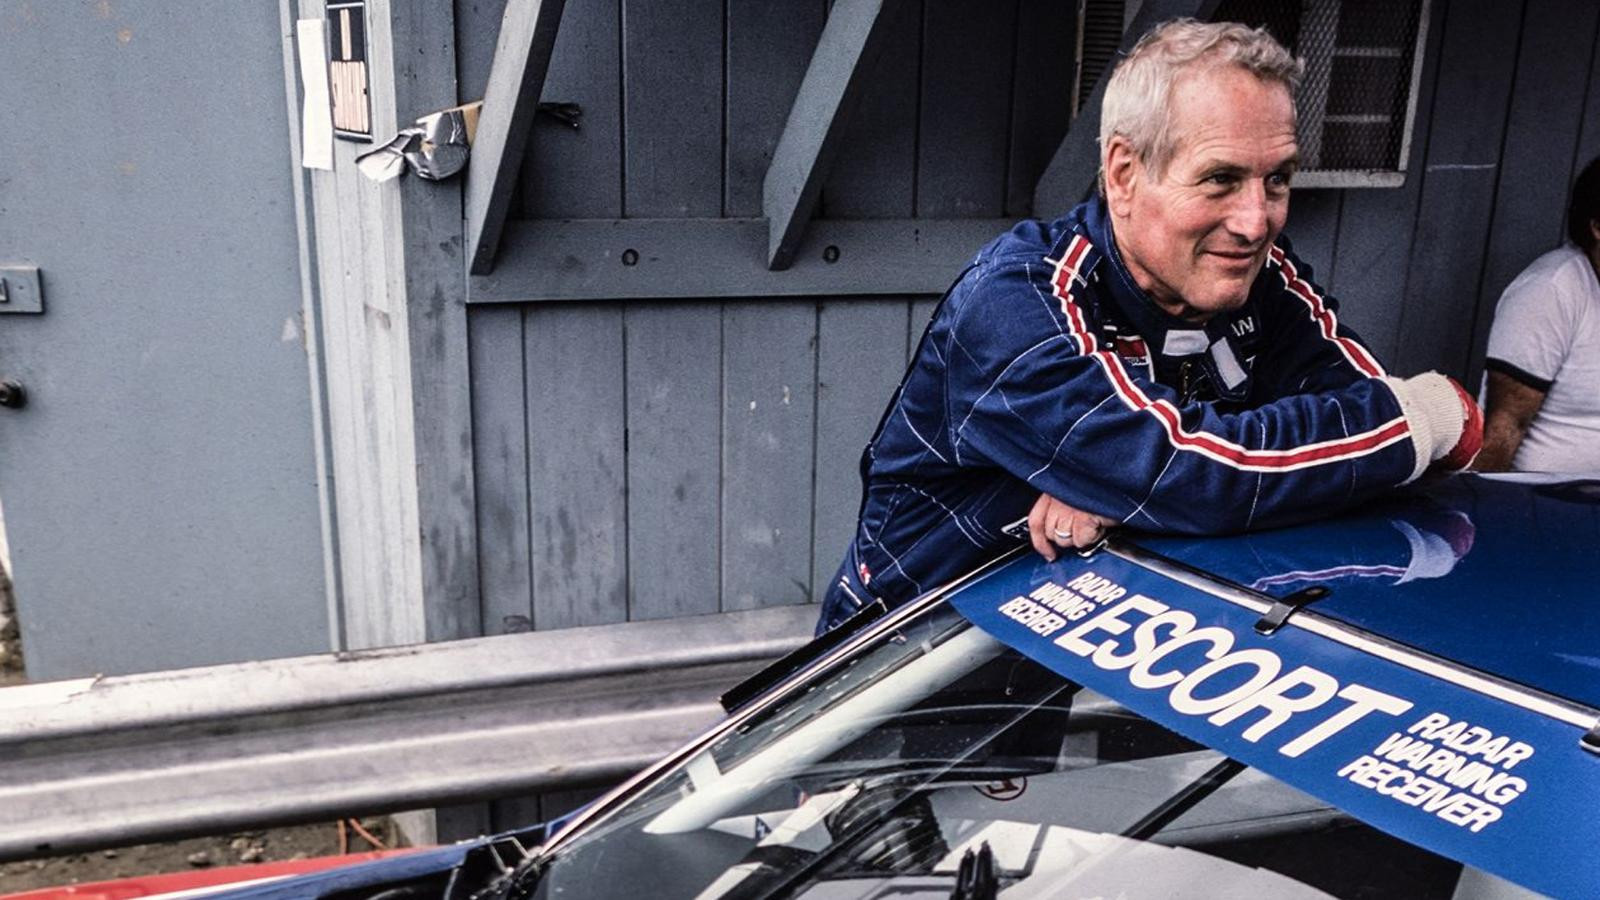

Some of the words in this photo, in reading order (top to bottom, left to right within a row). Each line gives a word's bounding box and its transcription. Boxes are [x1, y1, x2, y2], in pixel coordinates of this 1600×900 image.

[998, 595, 1068, 637] RECEIVER
[1029, 582, 1097, 621] WARNING
[1069, 571, 1127, 606] RADAR
[1054, 594, 1414, 758] ESCORT
[1374, 732, 1528, 806] WARNING
[1407, 712, 1535, 770] RADAR
[1337, 754, 1504, 833] RECEIVER
